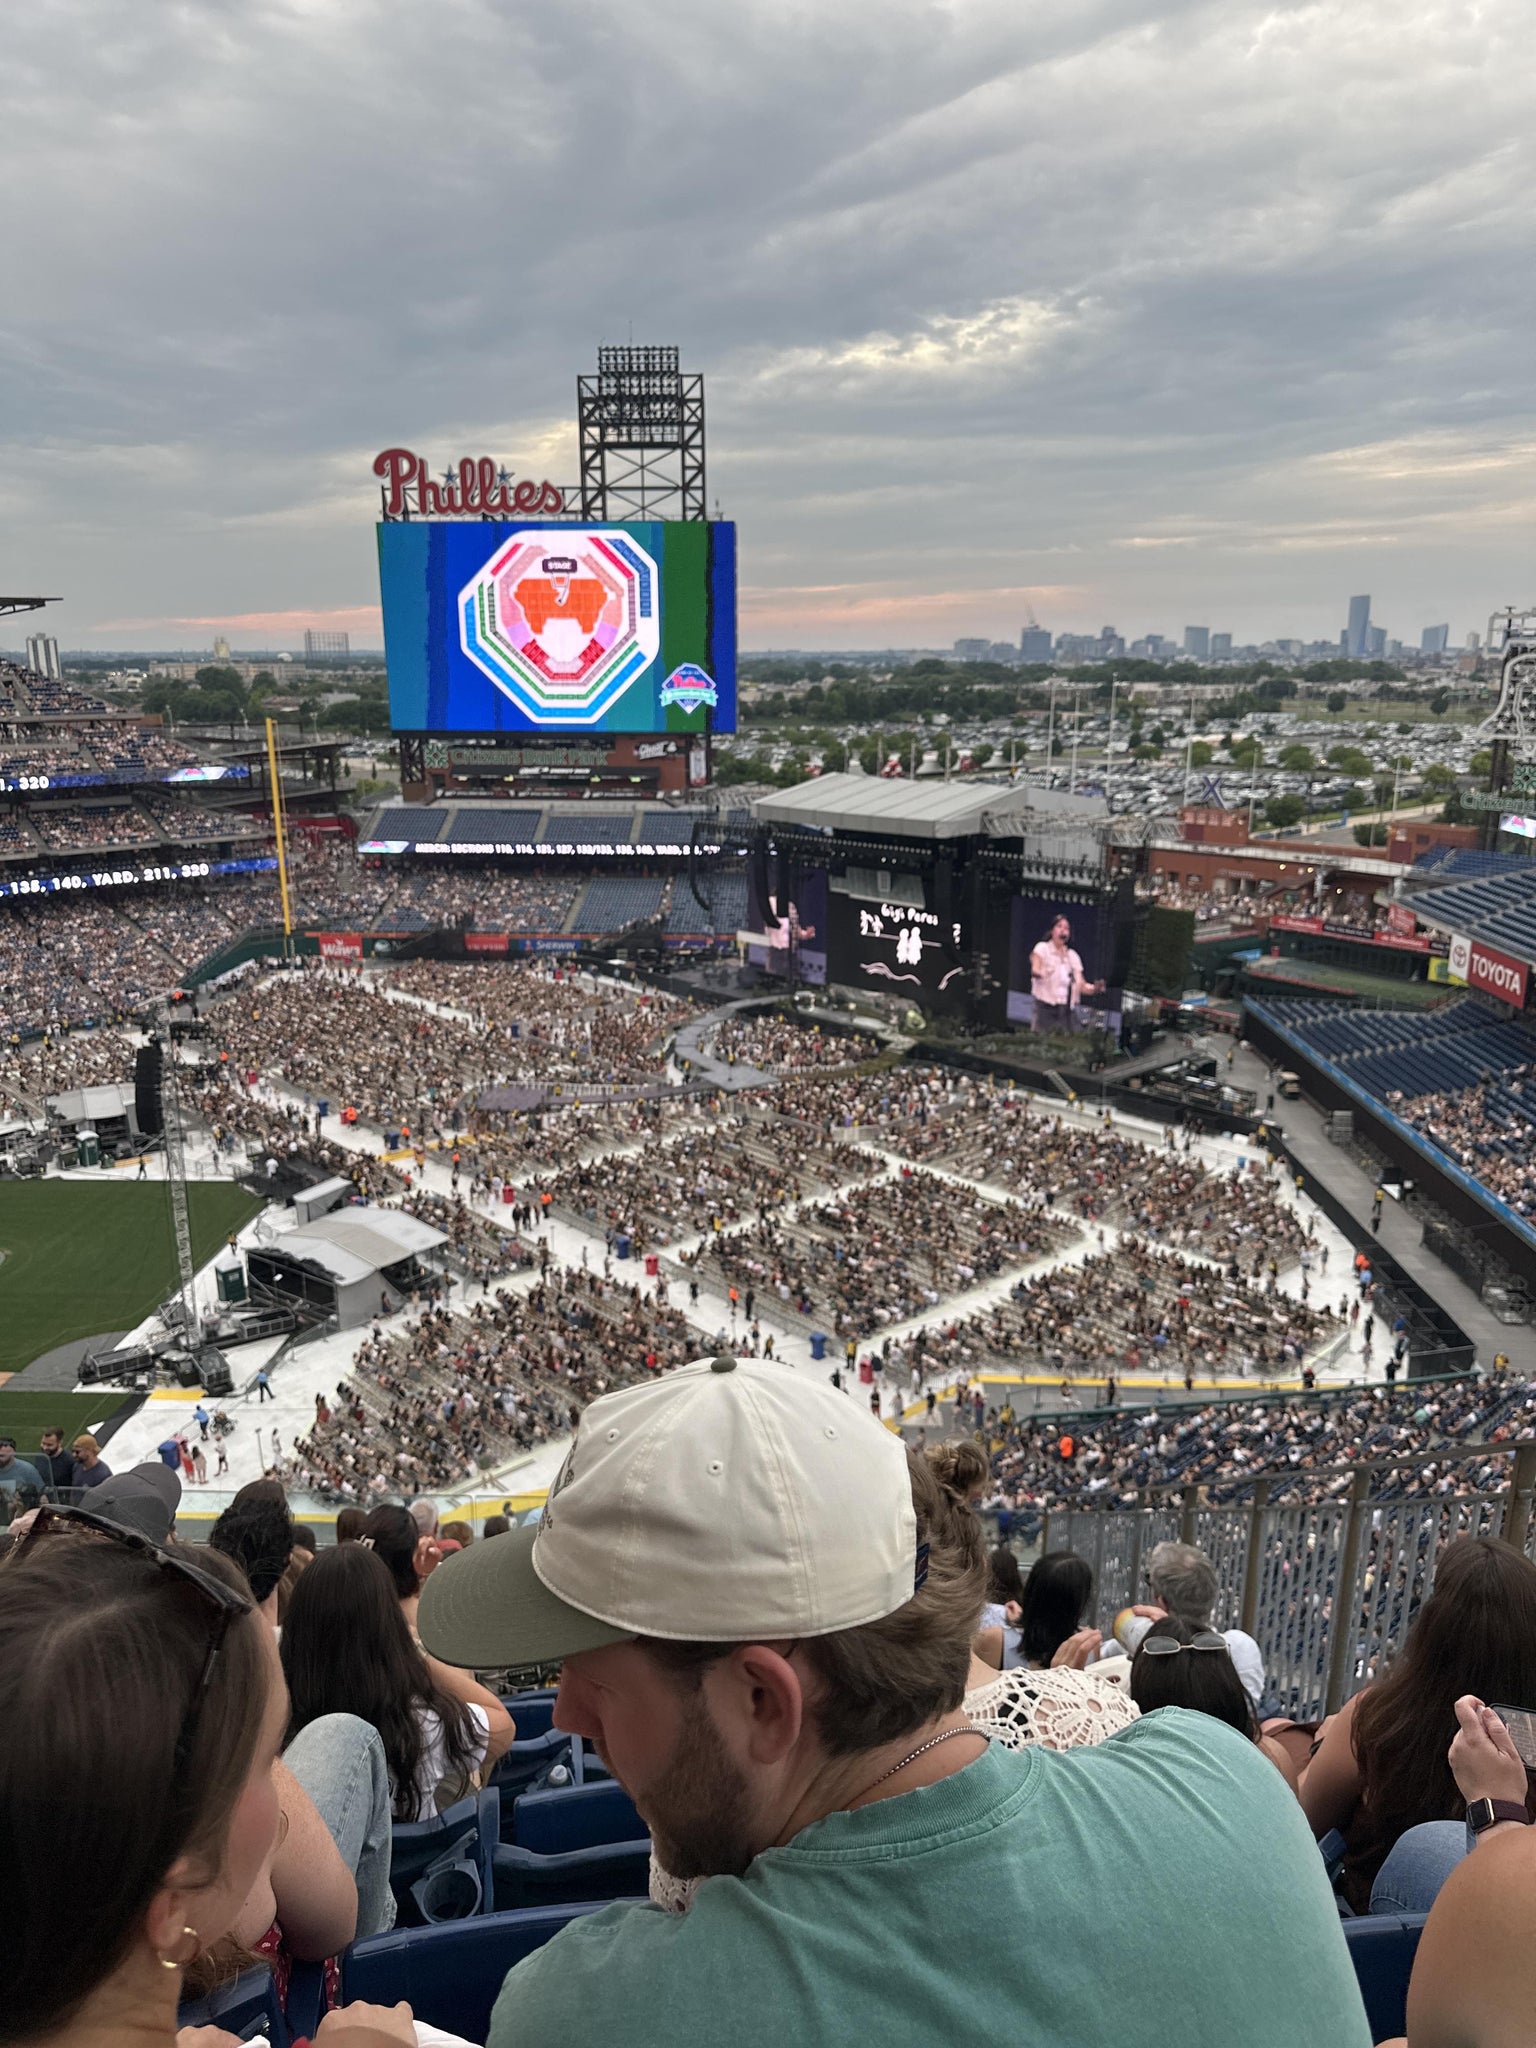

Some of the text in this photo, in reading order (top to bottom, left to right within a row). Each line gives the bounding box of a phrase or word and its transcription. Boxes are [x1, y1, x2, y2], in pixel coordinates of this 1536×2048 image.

[373, 448, 565, 514] Phillies
[548, 561, 572, 570] STAGE
[450, 748, 609, 766] Citizens Bank Park
[19, 775, 49, 790] 320
[10, 880, 47, 894] 135,
[52, 875, 87, 889] 140,
[92, 871, 139, 887] YARD,
[143, 867, 178, 881] 211,
[181, 863, 209, 877] 320
[322, 943, 361, 957] Wawa
[536, 941, 575, 950] SHERWIN
[1472, 952, 1521, 996] TOYOTA
